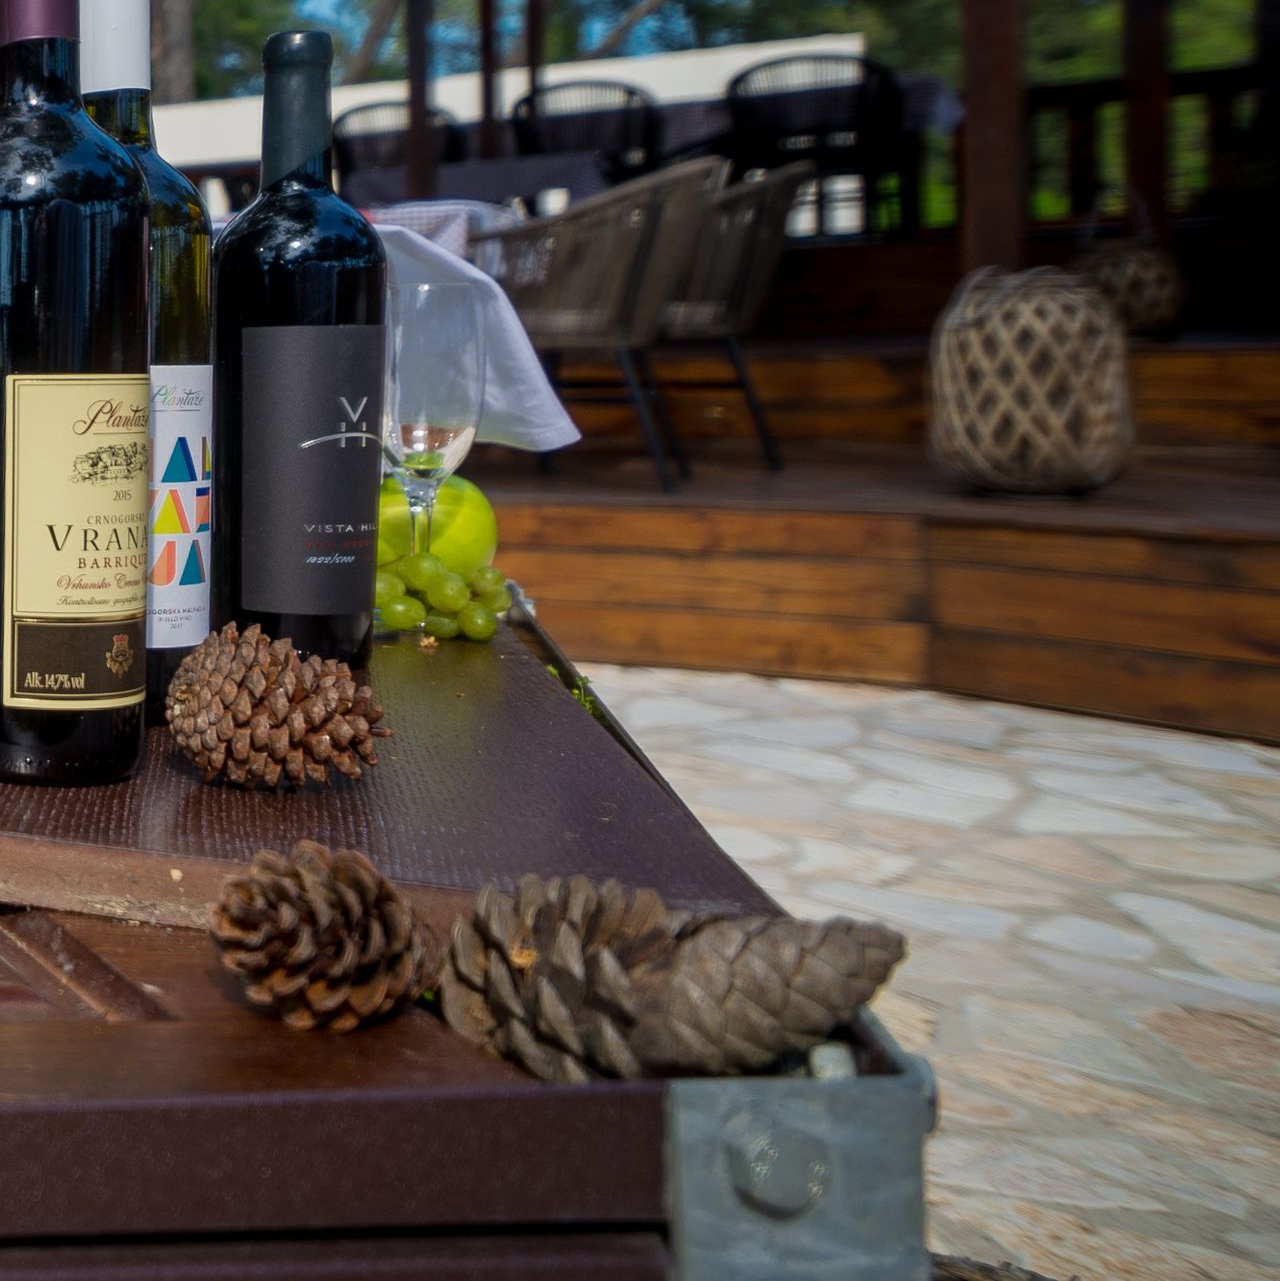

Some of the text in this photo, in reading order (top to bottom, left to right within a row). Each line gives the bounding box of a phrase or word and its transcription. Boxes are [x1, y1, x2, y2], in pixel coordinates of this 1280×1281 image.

[113, 490, 132, 502] 2015
[304, 524, 354, 533] VISTA
[24, 672, 43, 688] Alk.
[71, 672, 85, 688] vol
